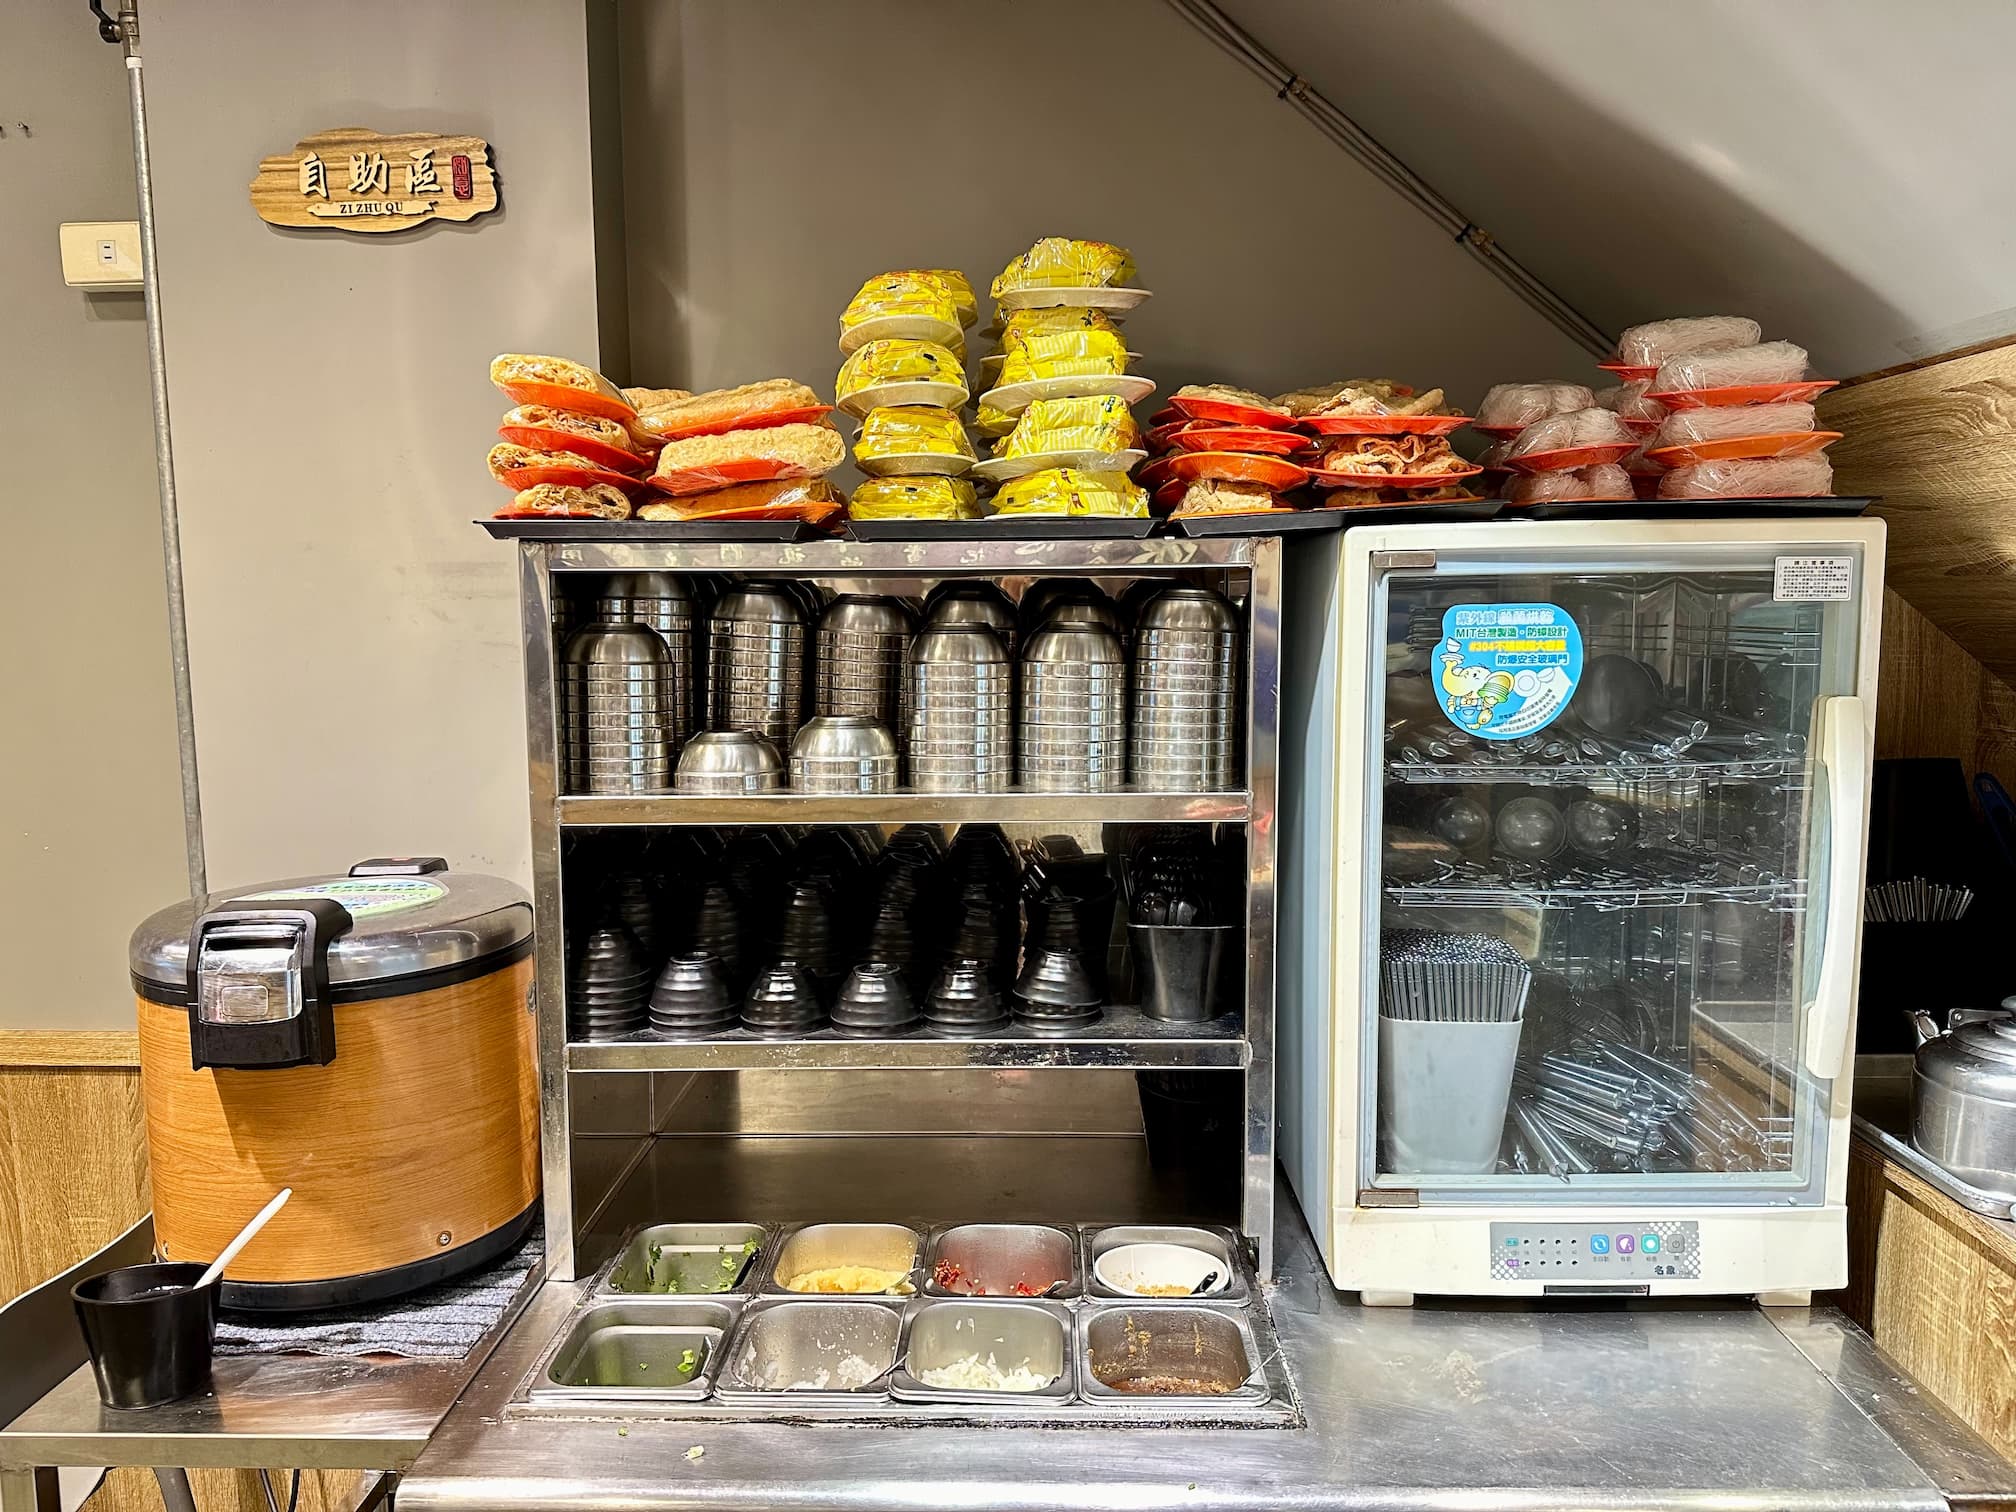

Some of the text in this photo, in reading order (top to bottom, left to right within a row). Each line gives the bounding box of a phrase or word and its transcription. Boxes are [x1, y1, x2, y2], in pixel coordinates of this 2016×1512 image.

[298, 148, 444, 198] 自助區
[340, 202, 404, 214] ZI ZHU QU
[1497, 655, 1568, 664] 防爆安全玻璃門
